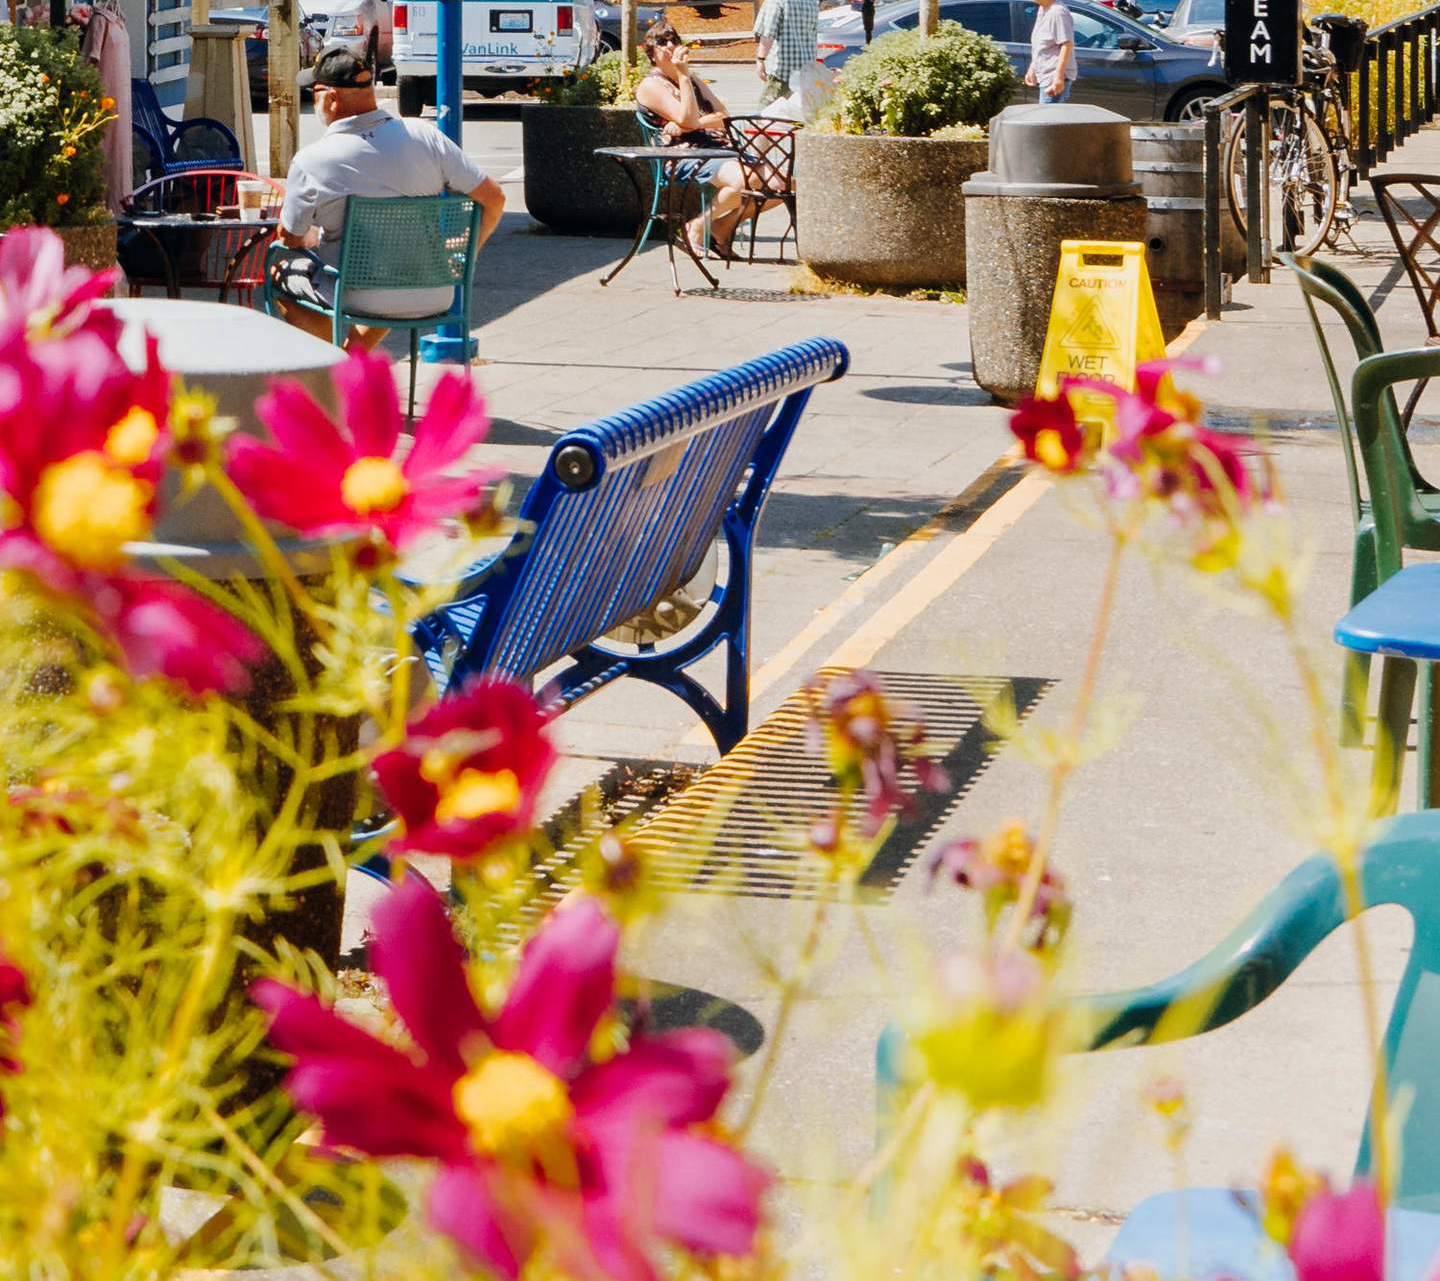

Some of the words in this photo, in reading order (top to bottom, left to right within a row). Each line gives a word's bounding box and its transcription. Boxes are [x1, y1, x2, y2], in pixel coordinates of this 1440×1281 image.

[462, 42, 519, 55] VanLink
[1069, 277, 1128, 290] CAUTION
[1068, 355, 1109, 370] WET
